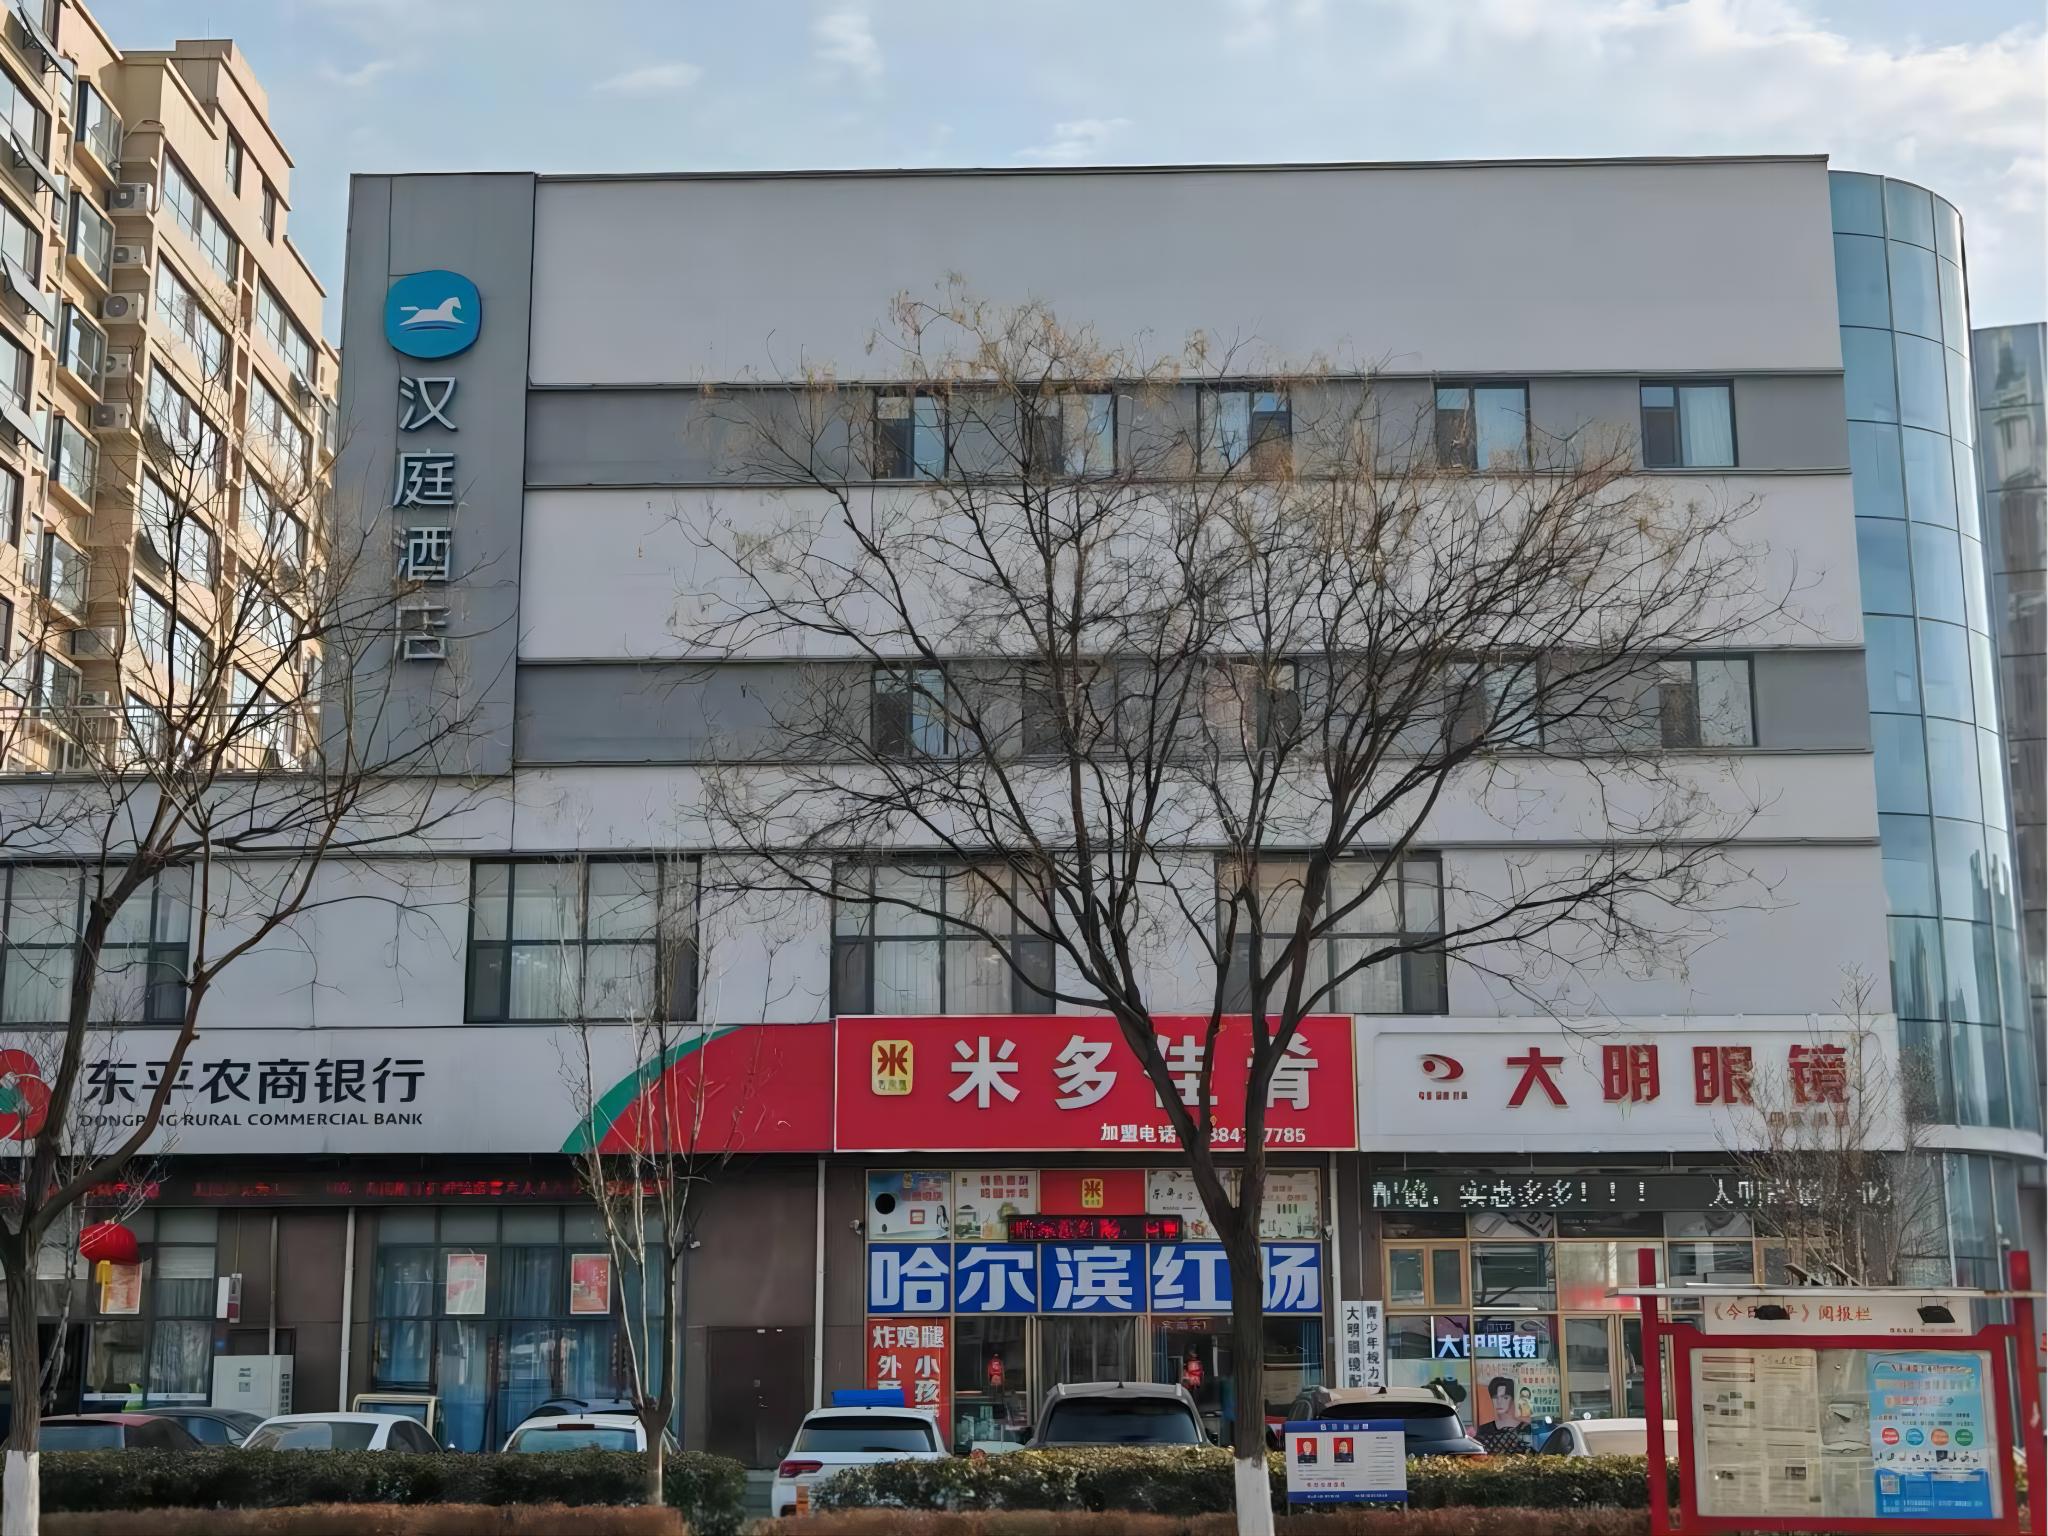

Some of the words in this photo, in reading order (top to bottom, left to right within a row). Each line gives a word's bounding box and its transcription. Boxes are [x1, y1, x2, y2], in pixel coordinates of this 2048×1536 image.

[393, 376, 457, 660] 汉庭酒店
[85, 1058, 426, 1105] 东平农商银行
[949, 1034, 1319, 1110] 米多佳肴
[1506, 1043, 1848, 1109] 大明眼镜
[79, 1113, 178, 1128] DONGPNG
[184, 1113, 242, 1127] RURAL
[247, 1112, 369, 1127] COMMERCIAL
[373, 1112, 424, 1126] BANK
[871, 1246, 1319, 1311] 哈尔滨红肠
[872, 1325, 945, 1349] 炸鸡腿
